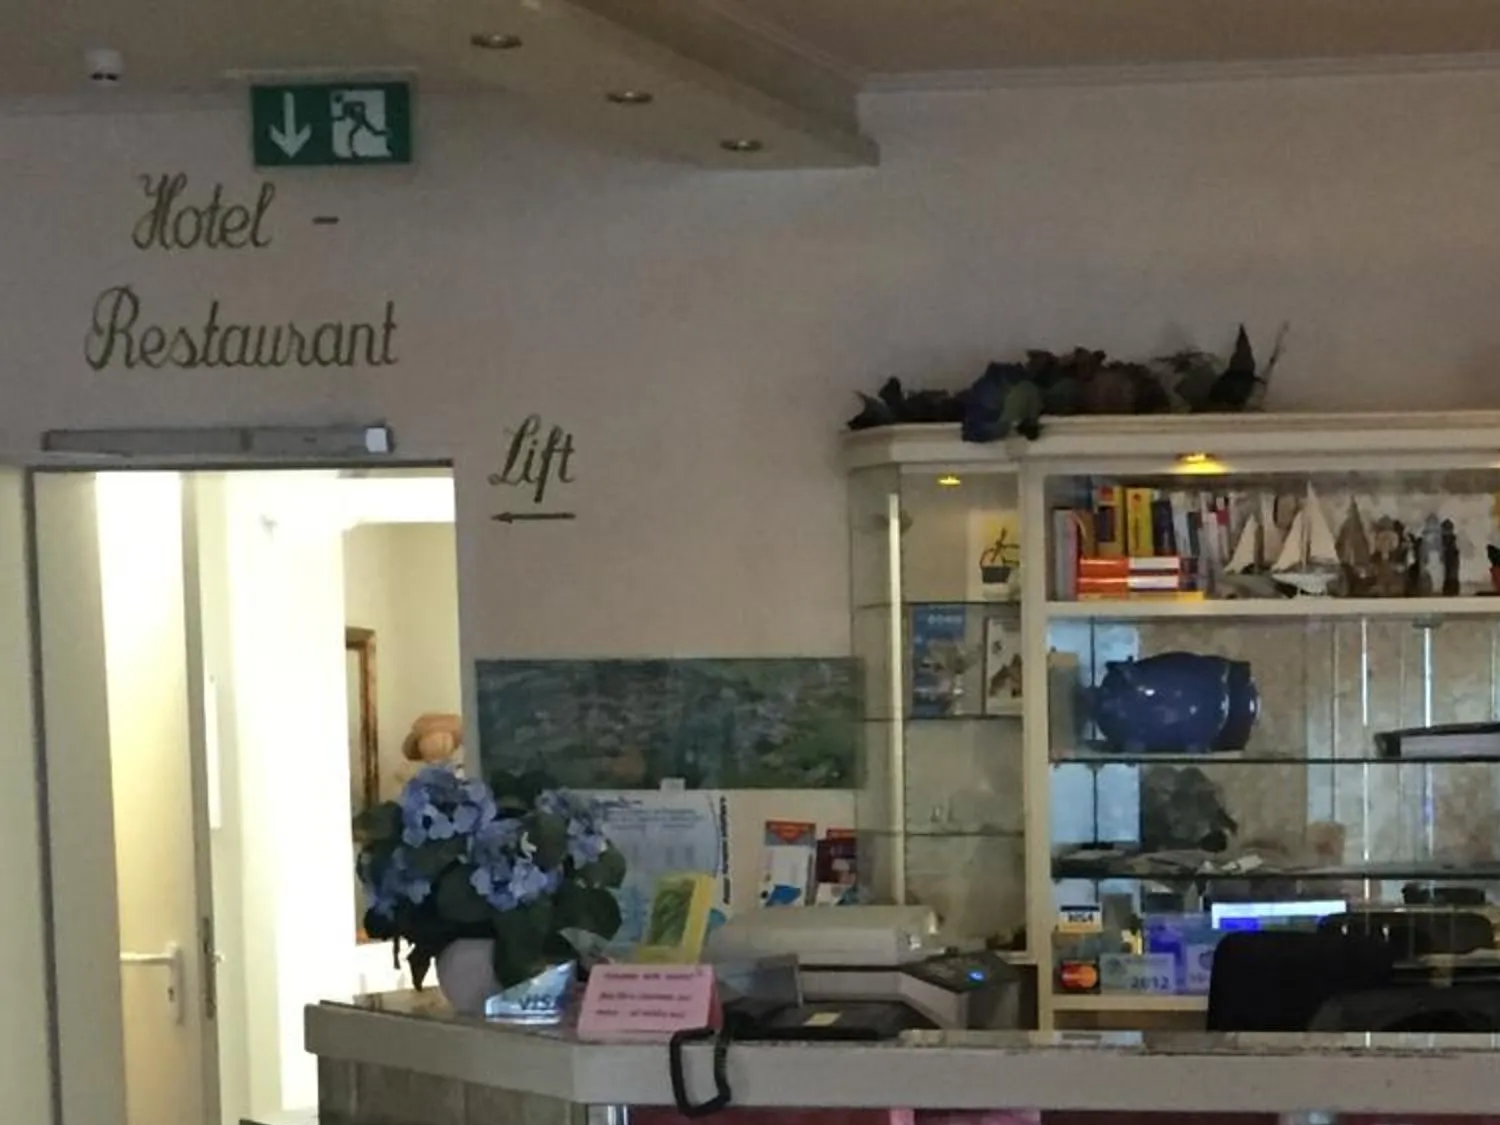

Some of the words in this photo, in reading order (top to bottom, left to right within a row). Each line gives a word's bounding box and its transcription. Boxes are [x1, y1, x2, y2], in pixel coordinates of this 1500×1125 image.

[132, 172, 276, 249] Hotel
[84, 286, 399, 370] Restaurant
[487, 414, 576, 503] Lift
